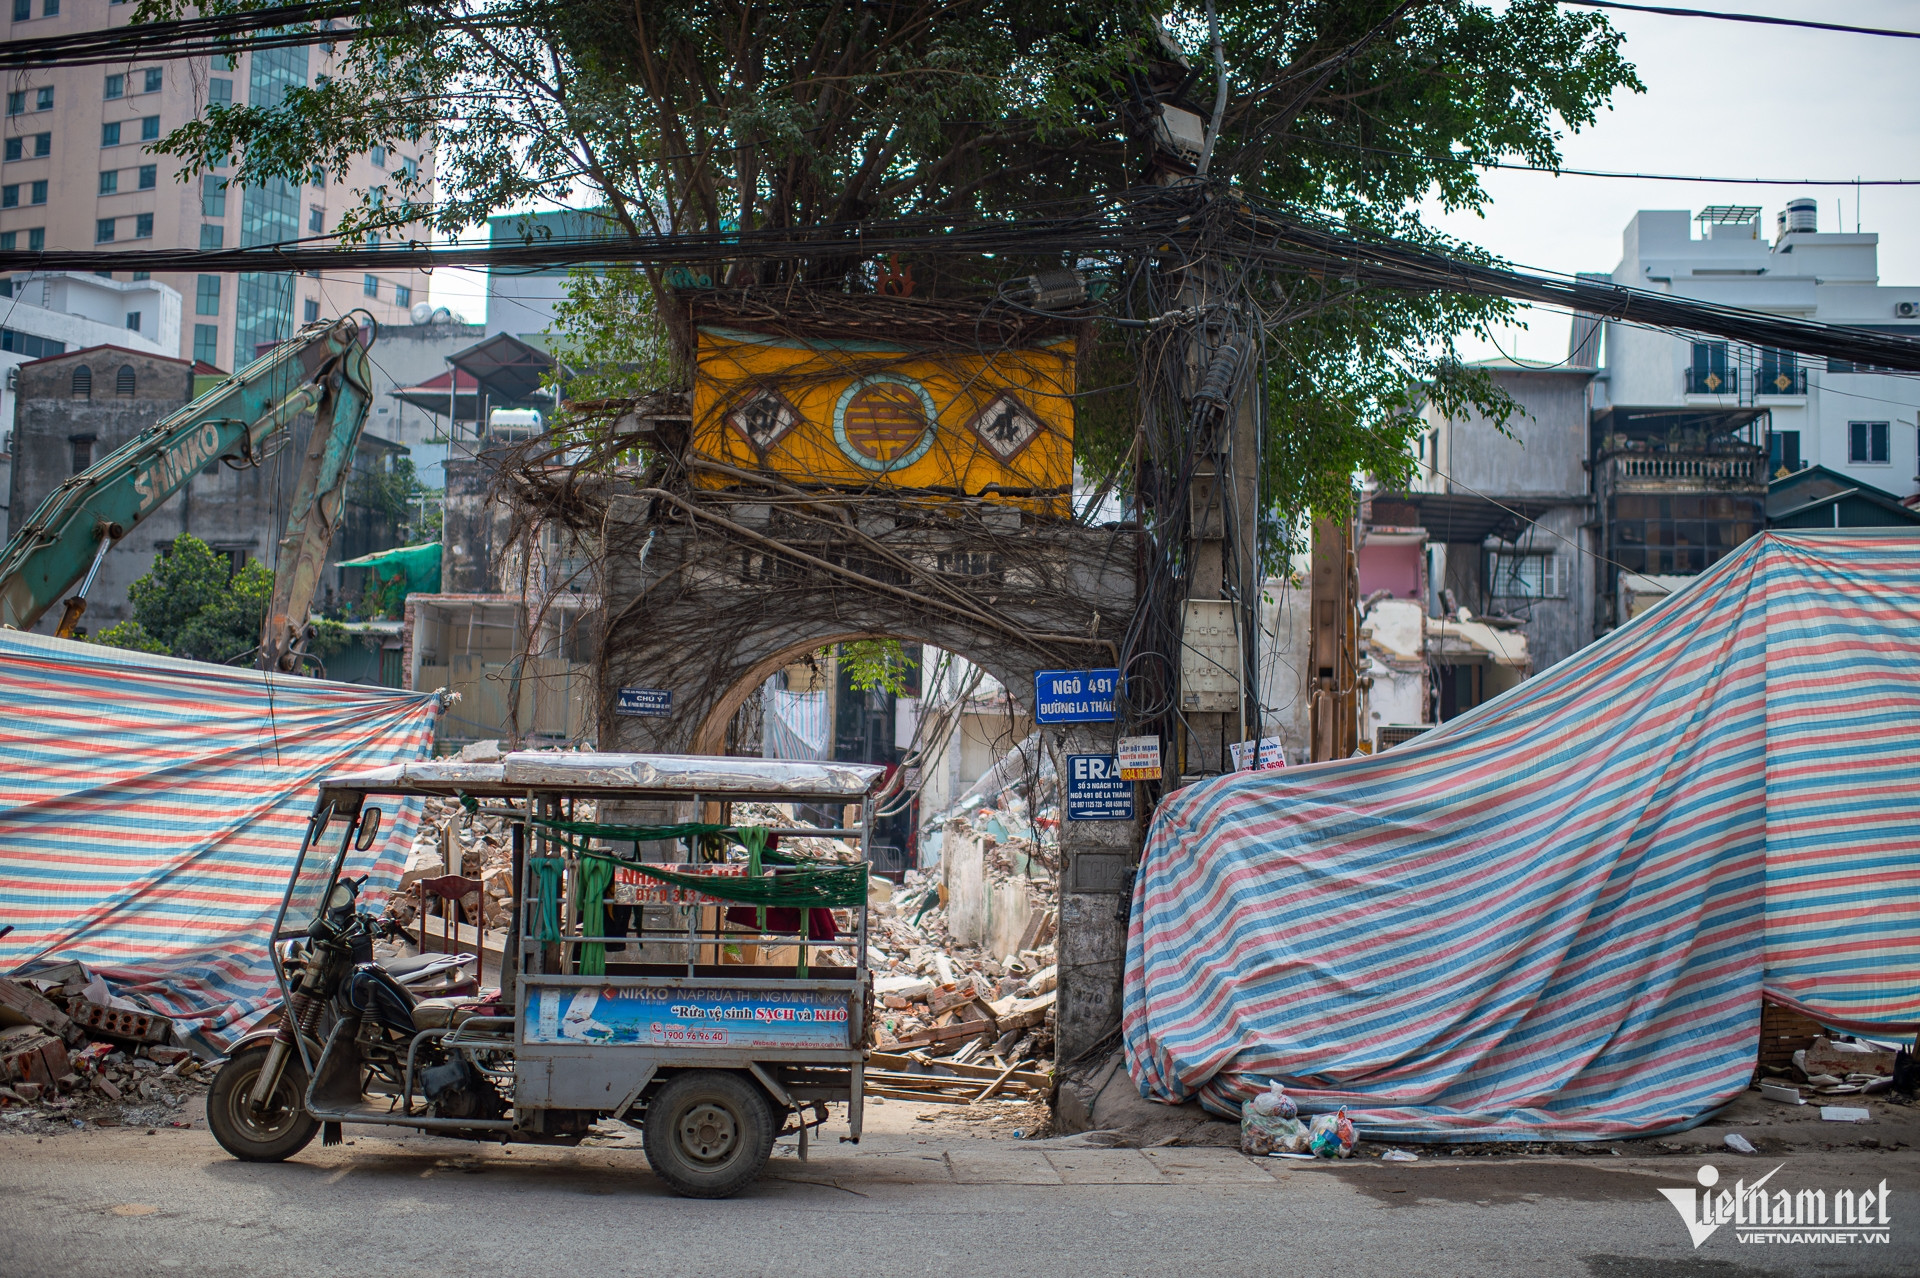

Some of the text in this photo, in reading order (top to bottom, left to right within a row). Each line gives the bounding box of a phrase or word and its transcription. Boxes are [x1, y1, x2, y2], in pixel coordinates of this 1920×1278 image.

[134, 424, 219, 511] SHINKO
[1052, 676, 1112, 695] NGÕ 491
[1040, 697, 1117, 715] ĐƯỜNG LA THÀN
[1074, 758, 1120, 779] ERA
[1112, 790, 1131, 798] THÀNH
[619, 988, 669, 1000] NIKKO
[736, 990, 781, 1002] THNG
[782, 992, 813, 1003] MINH
[708, 1006, 722, 1021] vệ
[724, 1007, 752, 1018] sinh
[756, 1008, 794, 1022] SẠCH
[798, 1009, 811, 1020] và
[815, 1008, 848, 1021] KHÔ
[664, 1032, 723, 1041] 1900 96 96 40
